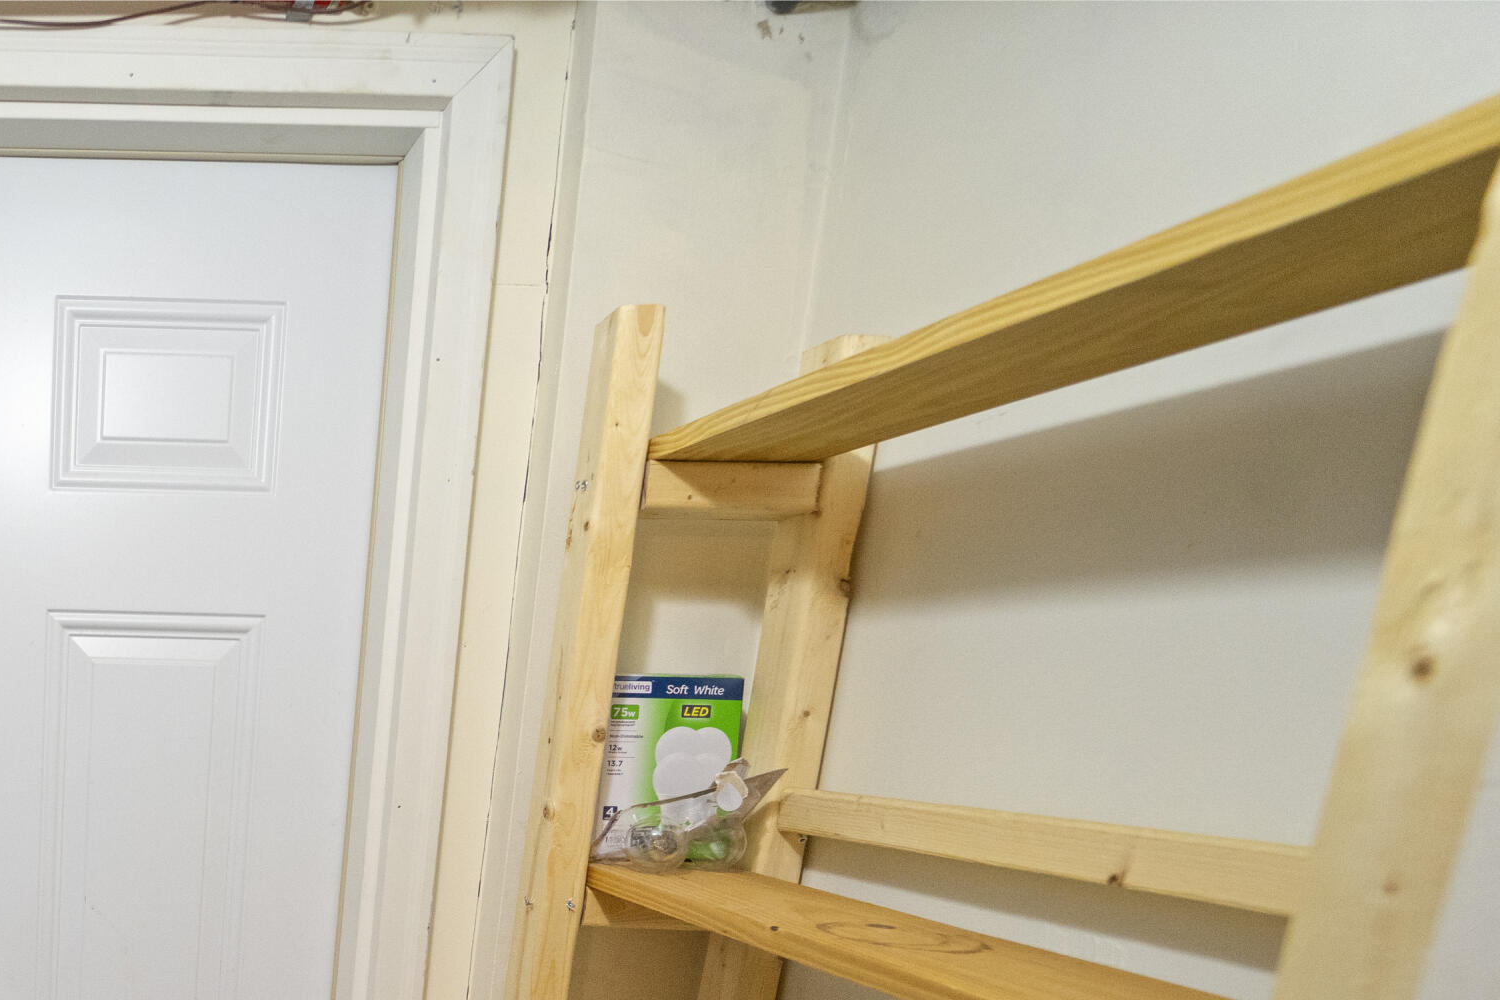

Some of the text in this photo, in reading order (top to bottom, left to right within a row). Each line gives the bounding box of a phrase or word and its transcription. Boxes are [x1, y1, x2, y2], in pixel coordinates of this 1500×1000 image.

[666, 684, 724, 696] Soft White
[683, 707, 709, 717] LED
